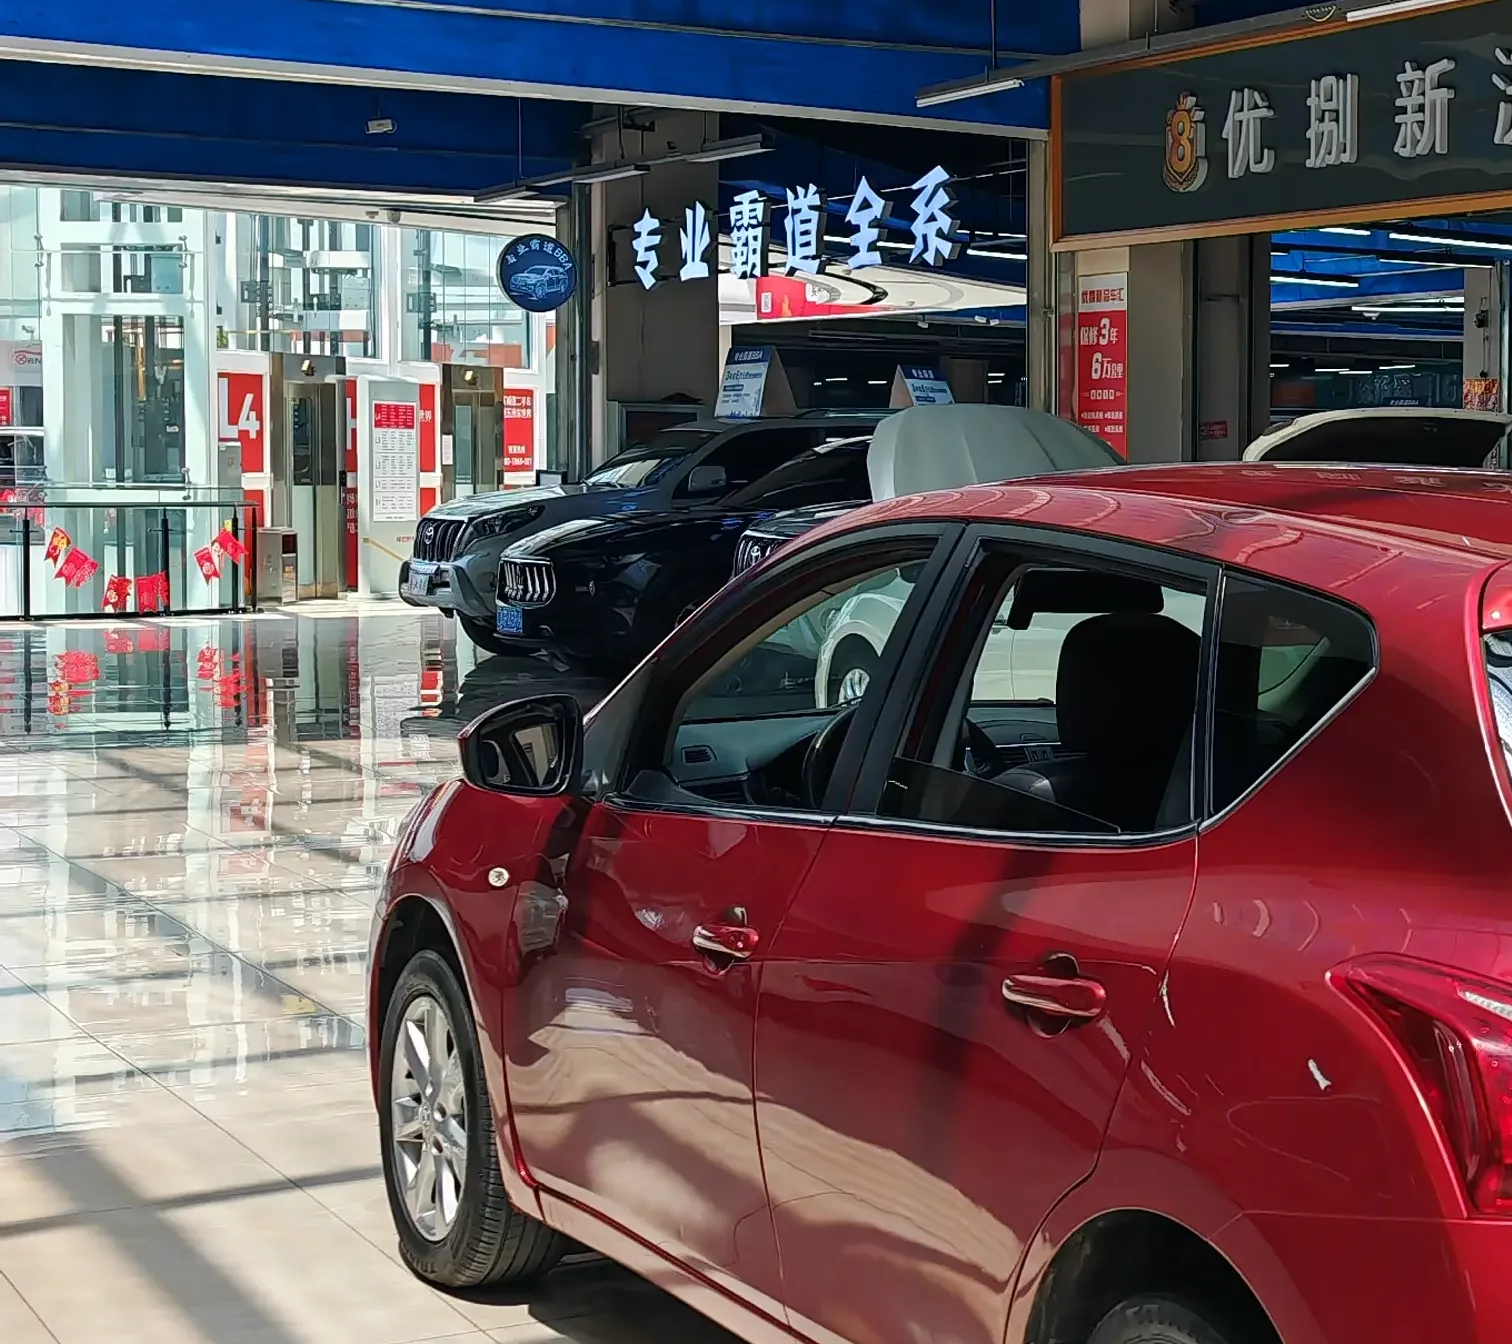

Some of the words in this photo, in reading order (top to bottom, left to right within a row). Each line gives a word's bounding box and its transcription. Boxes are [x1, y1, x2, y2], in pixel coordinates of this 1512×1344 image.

[632, 165, 952, 290] 专业霸道全系
